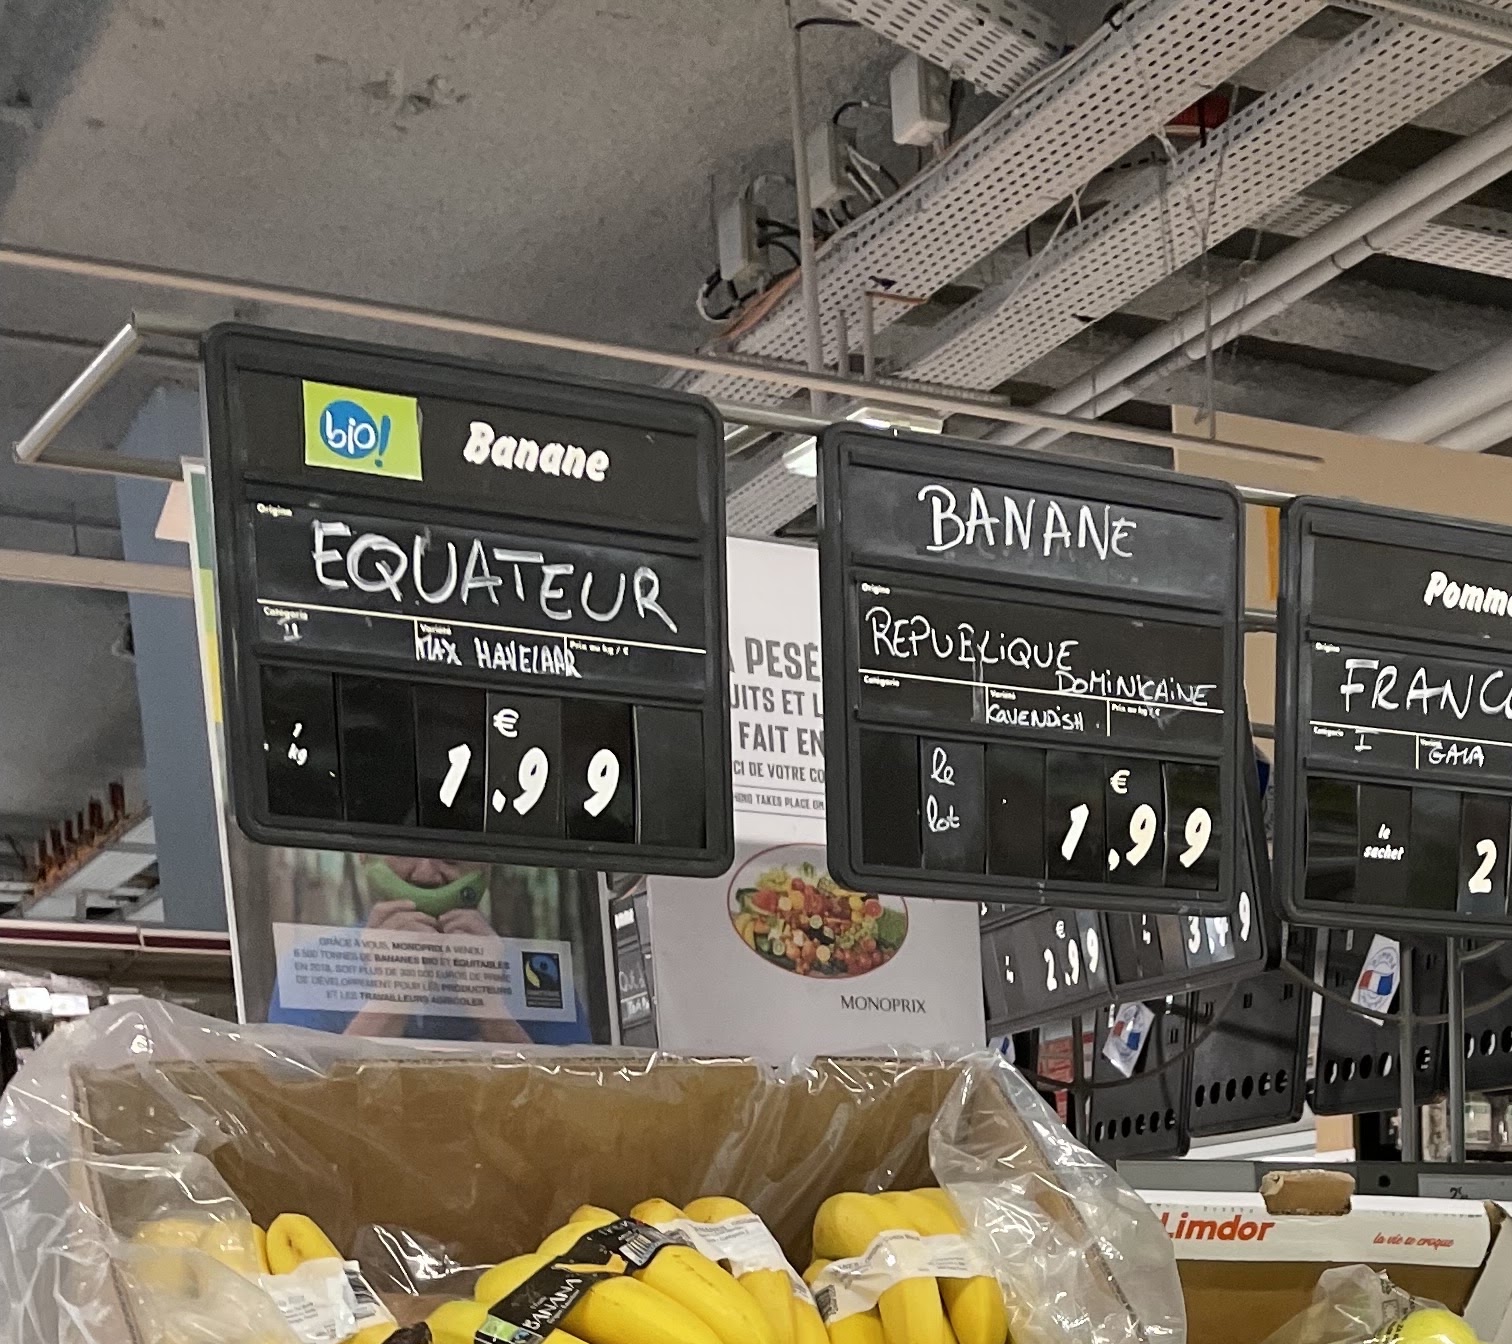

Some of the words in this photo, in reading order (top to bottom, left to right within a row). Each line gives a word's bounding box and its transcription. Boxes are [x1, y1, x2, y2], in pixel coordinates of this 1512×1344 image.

[321, 400, 391, 468] bio!
[462, 420, 610, 482] Banane
[918, 484, 1137, 559] BANANE
[311, 519, 678, 633] EQUATEUR
[414, 634, 462, 667] MAX
[474, 638, 582, 679] HAVELAAR
[865, 606, 1079, 671] REPUBLIQUE
[745, 637, 821, 683] PESÉ
[782, 689, 805, 716] ET
[1055, 669, 1218, 707] DOMINICAINE
[493, 707, 519, 738] €
[738, 721, 789, 754] FAIT
[797, 728, 825, 758] EN
[287, 743, 308, 766] kg
[749, 763, 764, 778] DE
[767, 764, 805, 783] VOTRE
[1110, 769, 1131, 794] €
[926, 795, 960, 832] lot
[1378, 823, 1389, 841] le
[1363, 841, 1405, 863] sachet
[841, 995, 927, 1013] MONOPRIX
[1160, 1211, 1276, 1242] Limdor
